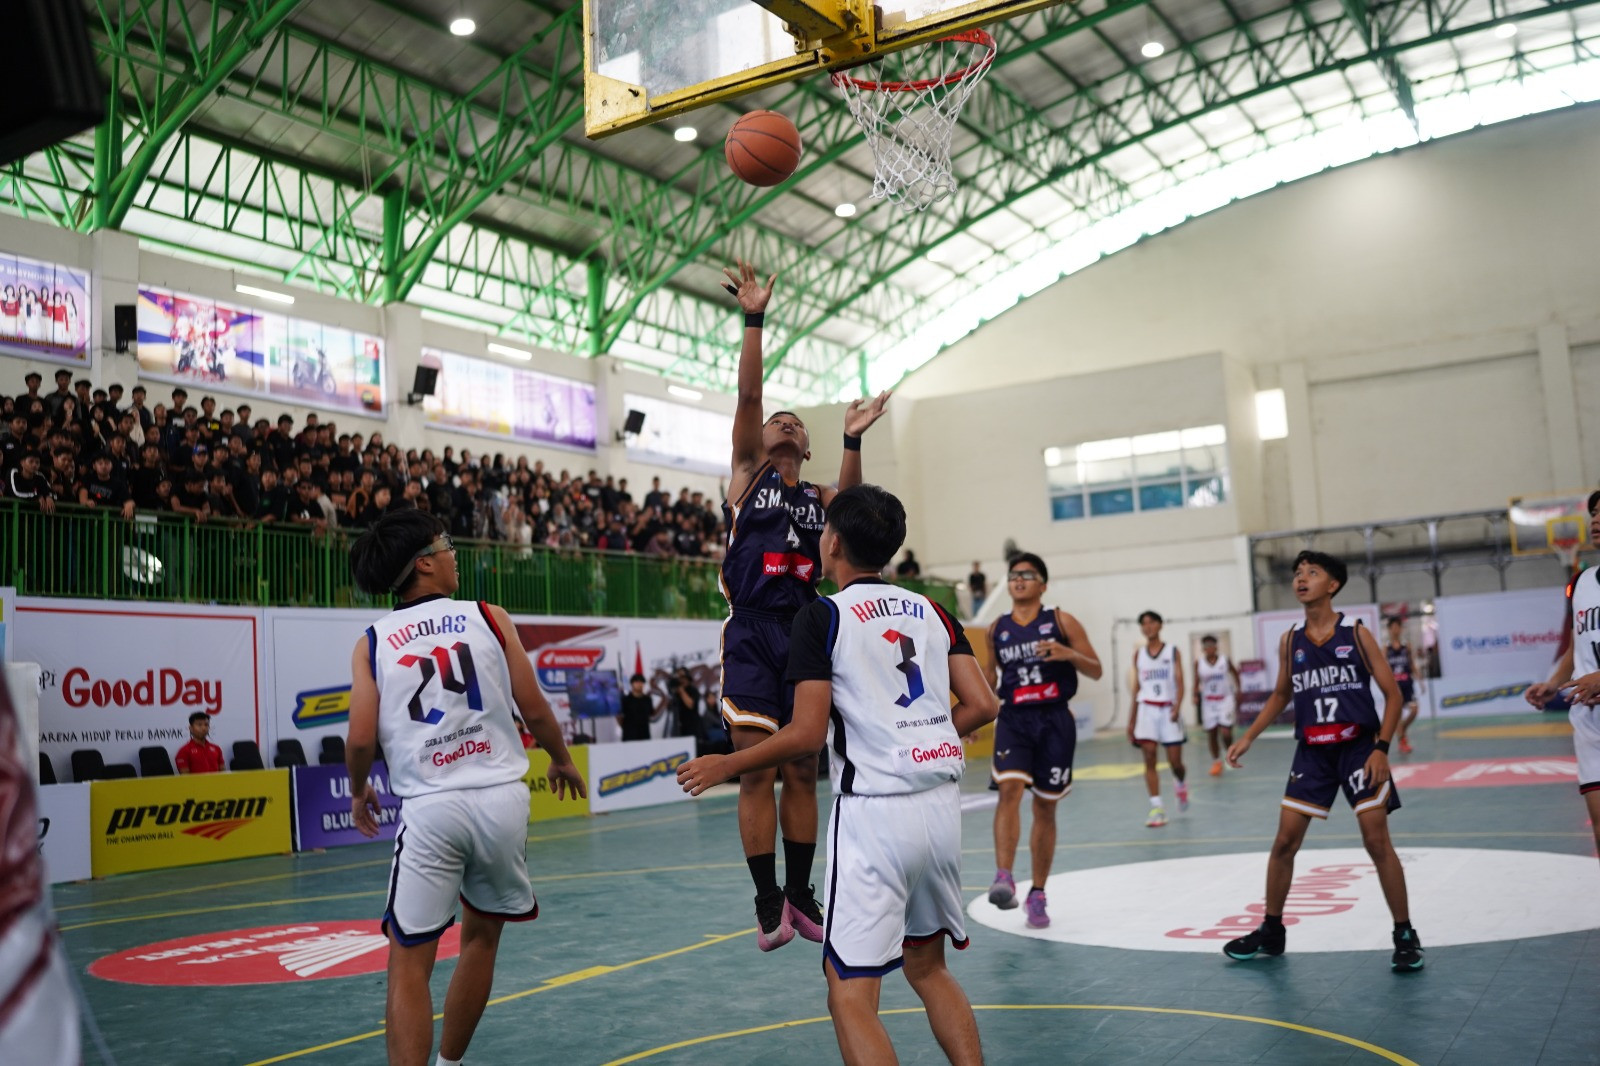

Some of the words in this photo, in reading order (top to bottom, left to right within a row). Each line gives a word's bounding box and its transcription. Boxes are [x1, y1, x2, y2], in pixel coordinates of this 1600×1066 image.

[786, 524, 800, 549] 4
[881, 628, 925, 708] 3
[1017, 665, 1042, 686] 34
[1292, 665, 1358, 693] SMANPAT
[397, 641, 483, 725] 24
[1313, 697, 1339, 723] 17
[39, 731, 78, 743] ARENA
[81, 729, 112, 743] HIDUP
[115, 729, 144, 742] PERLU
[147, 728, 184, 740] BANYAK
[1049, 766, 1071, 785] 34
[1349, 768, 1366, 795] 17
[106, 796, 268, 835] proteam
[121, 832, 157, 844] CHAMPION
[157, 831, 175, 840] BALL
